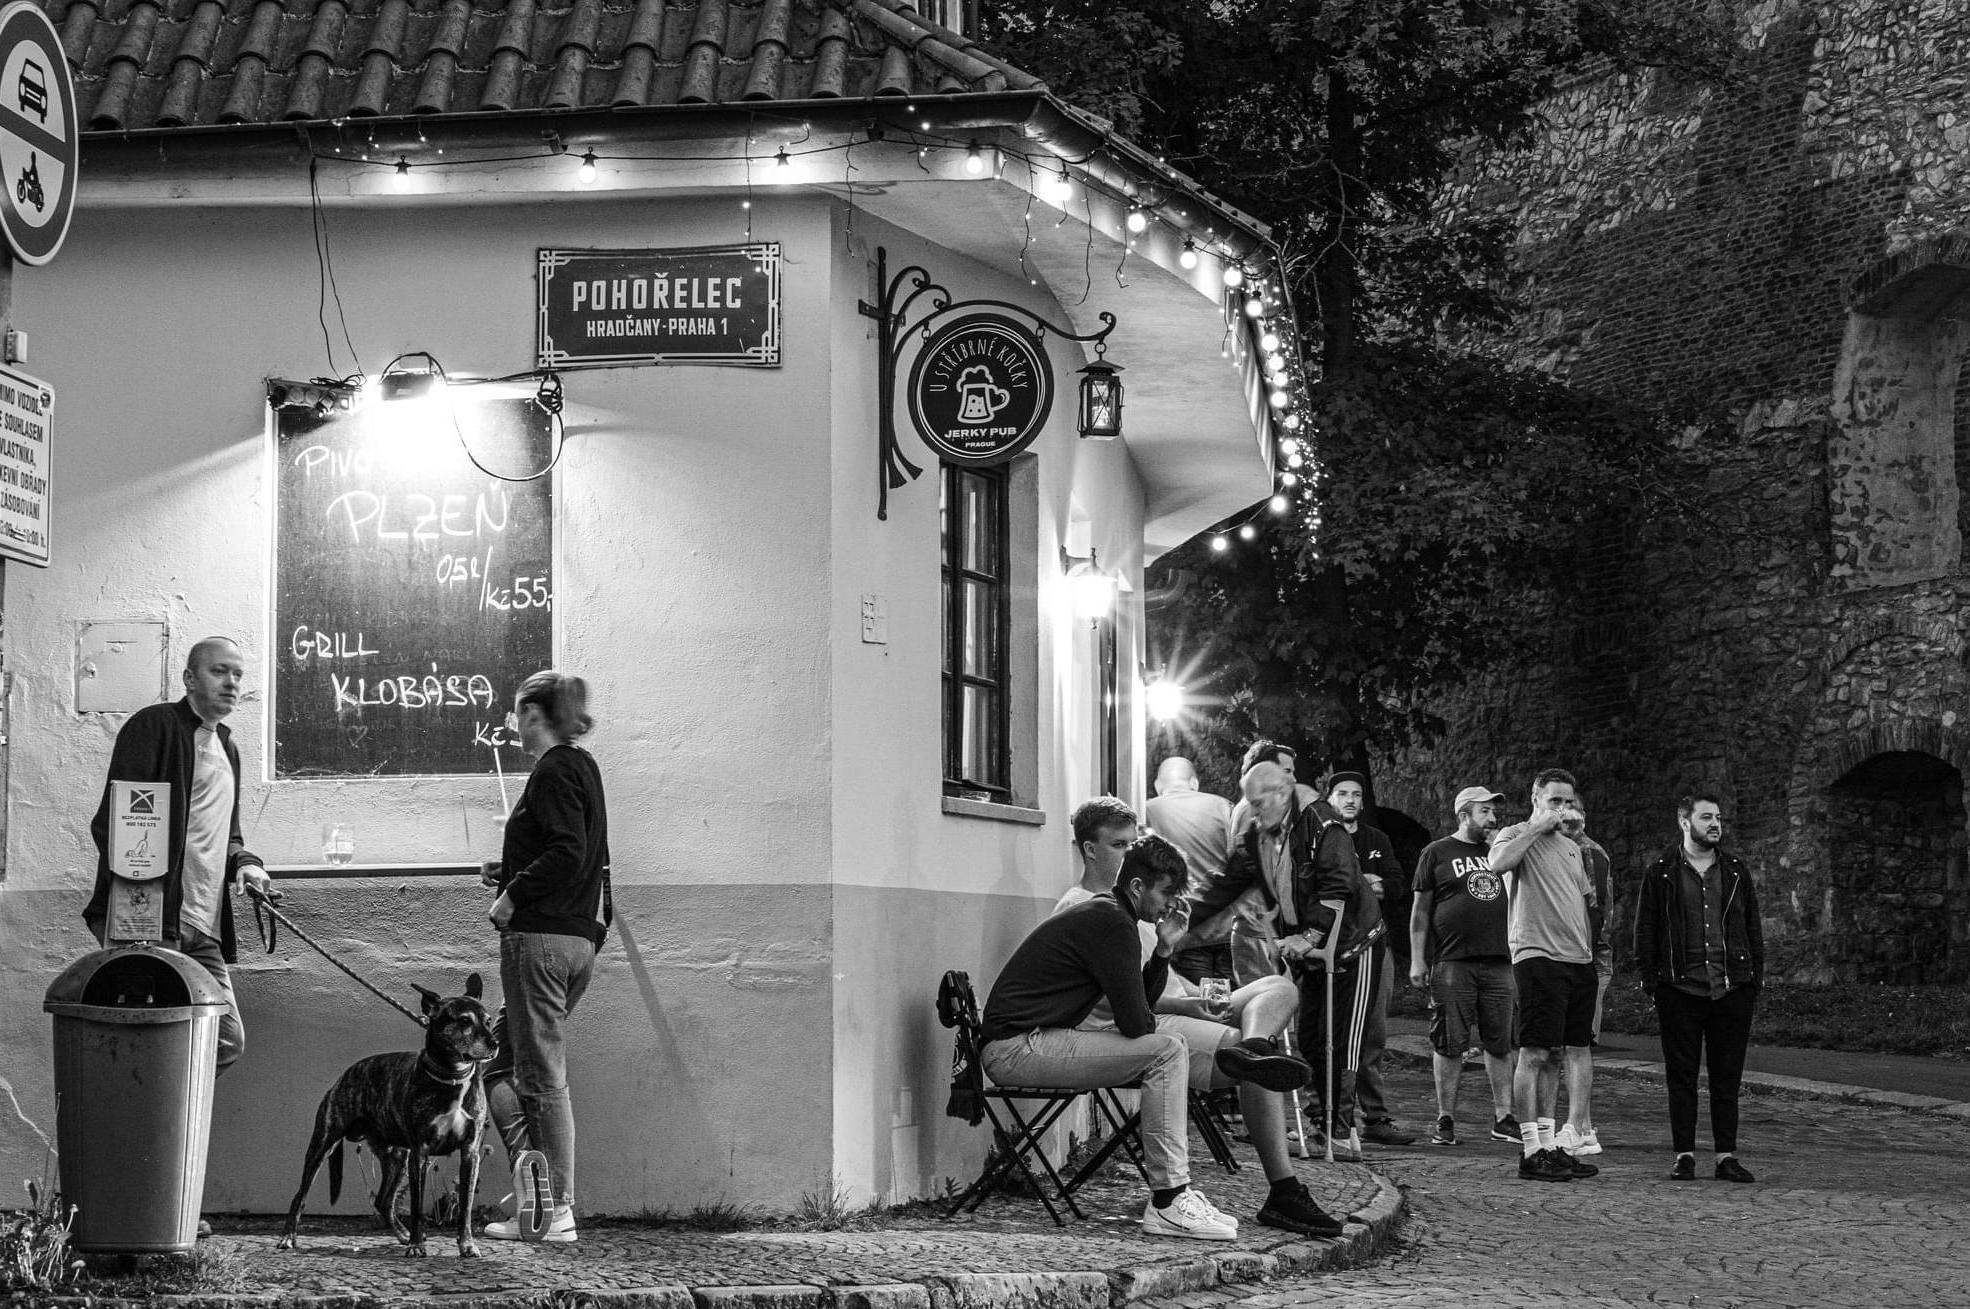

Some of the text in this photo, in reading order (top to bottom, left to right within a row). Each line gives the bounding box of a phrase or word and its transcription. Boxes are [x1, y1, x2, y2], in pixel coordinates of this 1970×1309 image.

[572, 272, 742, 312] POHOŘELEC
[720, 317, 728, 336] 1
[944, 426, 1017, 439] JERKY PUB
[965, 440, 996, 448] PRAGUE
[292, 625, 380, 660] GRILL
[331, 662, 494, 712] KLOBÁSA
[1451, 856, 1492, 878] GAN
